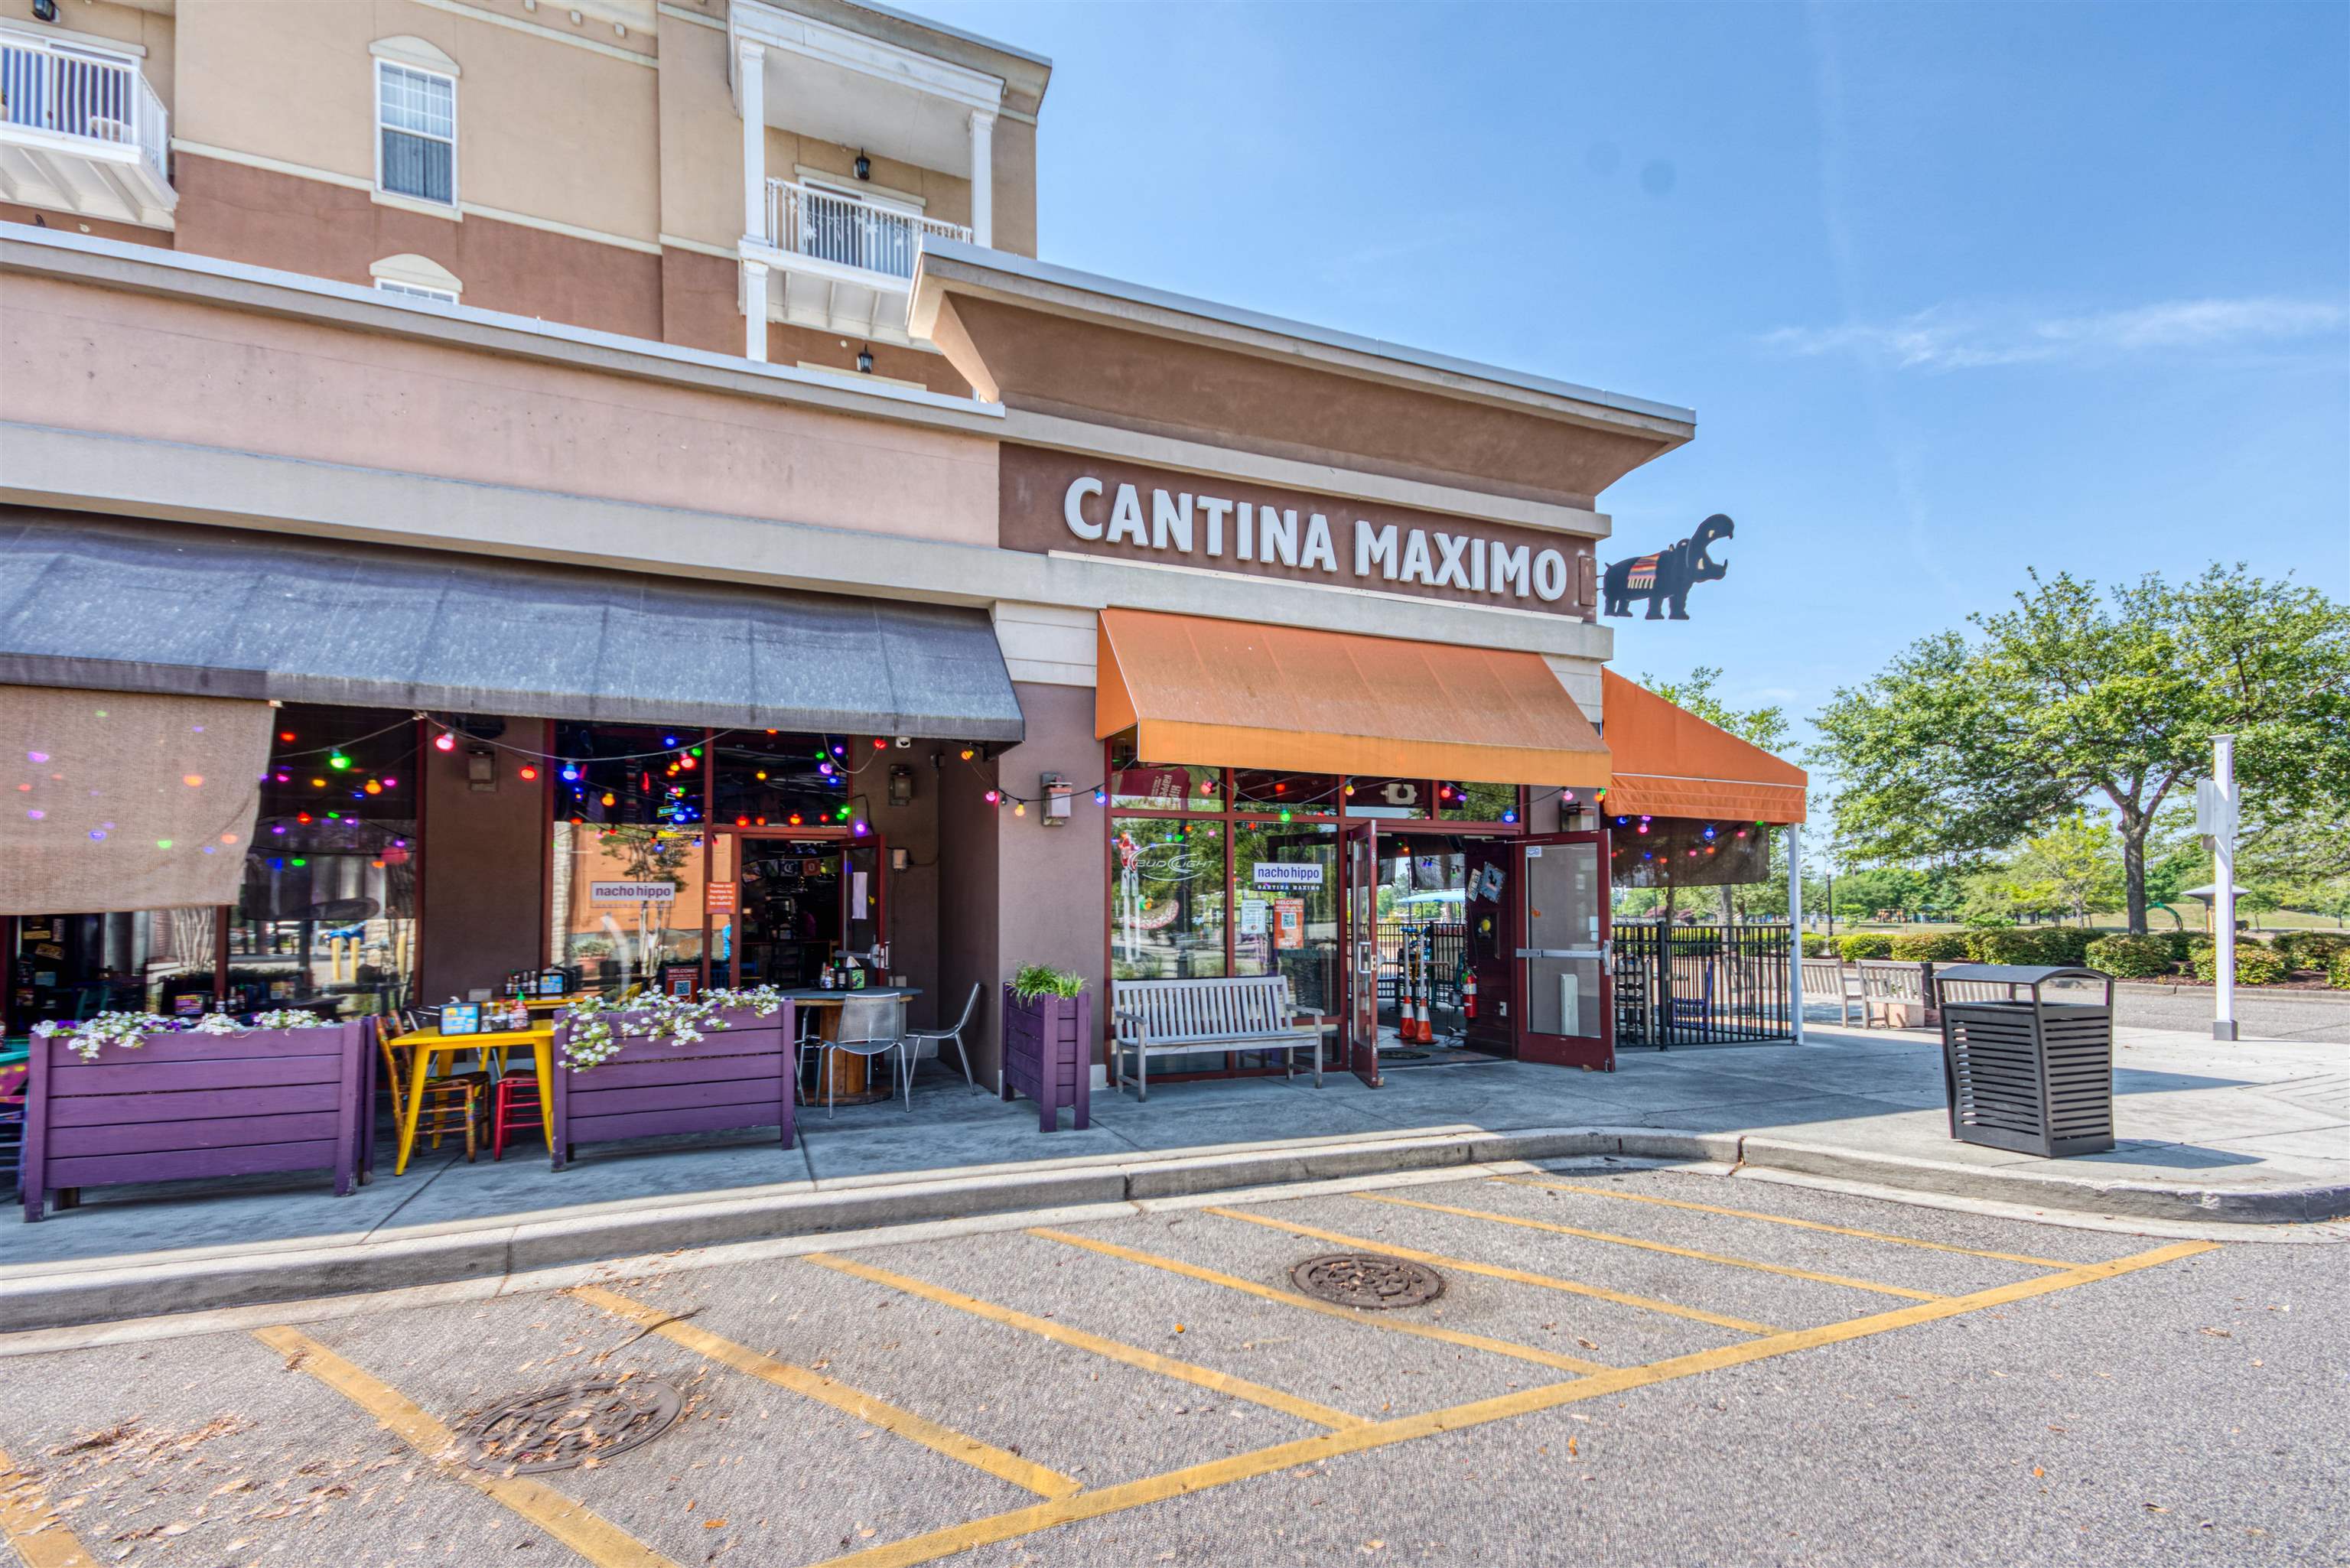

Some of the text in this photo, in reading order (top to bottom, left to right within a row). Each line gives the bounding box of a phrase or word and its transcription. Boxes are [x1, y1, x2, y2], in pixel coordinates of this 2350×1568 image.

[1064, 477, 1567, 601] CANTINA MAXIMO
[1258, 867, 1320, 880] nacho hippo
[595, 886, 671, 898] nacho hippo
